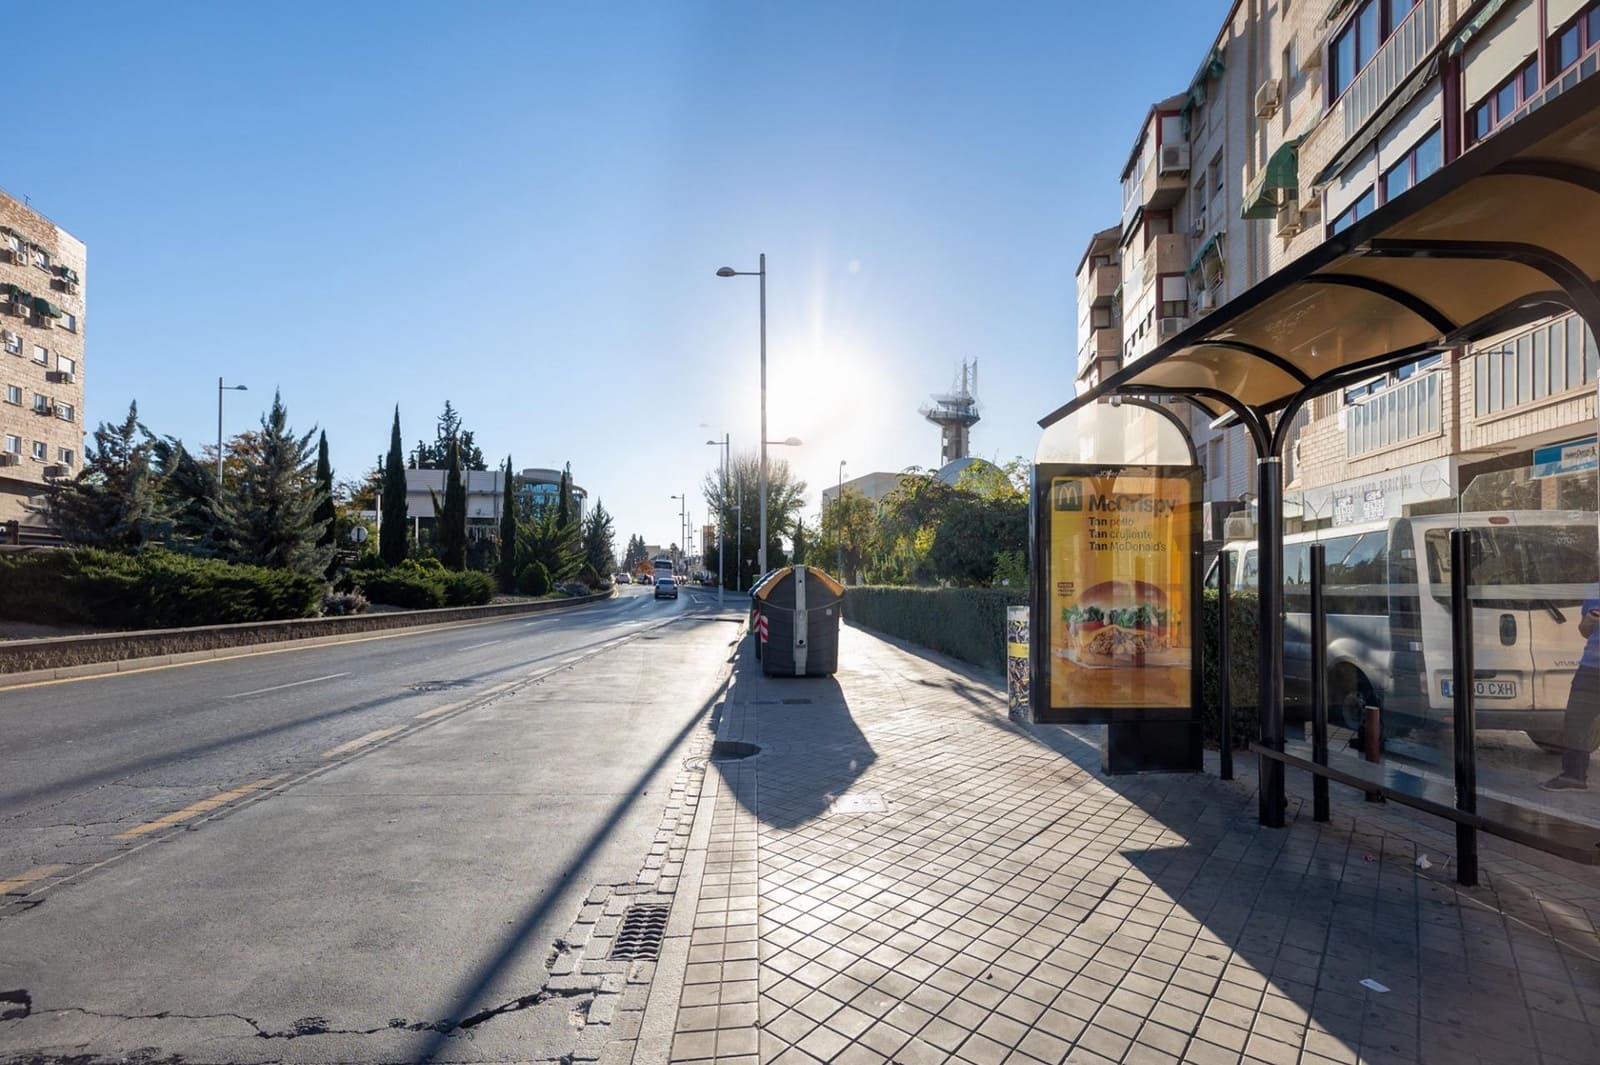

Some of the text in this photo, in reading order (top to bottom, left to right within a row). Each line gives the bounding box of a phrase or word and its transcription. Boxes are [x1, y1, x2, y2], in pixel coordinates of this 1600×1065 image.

[1088, 494, 1176, 518] McCrispy
[1088, 516, 1134, 529] Tan pollo
[1088, 528, 1153, 541] Tan crujiente
[1088, 541, 1167, 552] Tan McDonald's
[1488, 682, 1513, 696] CXH
